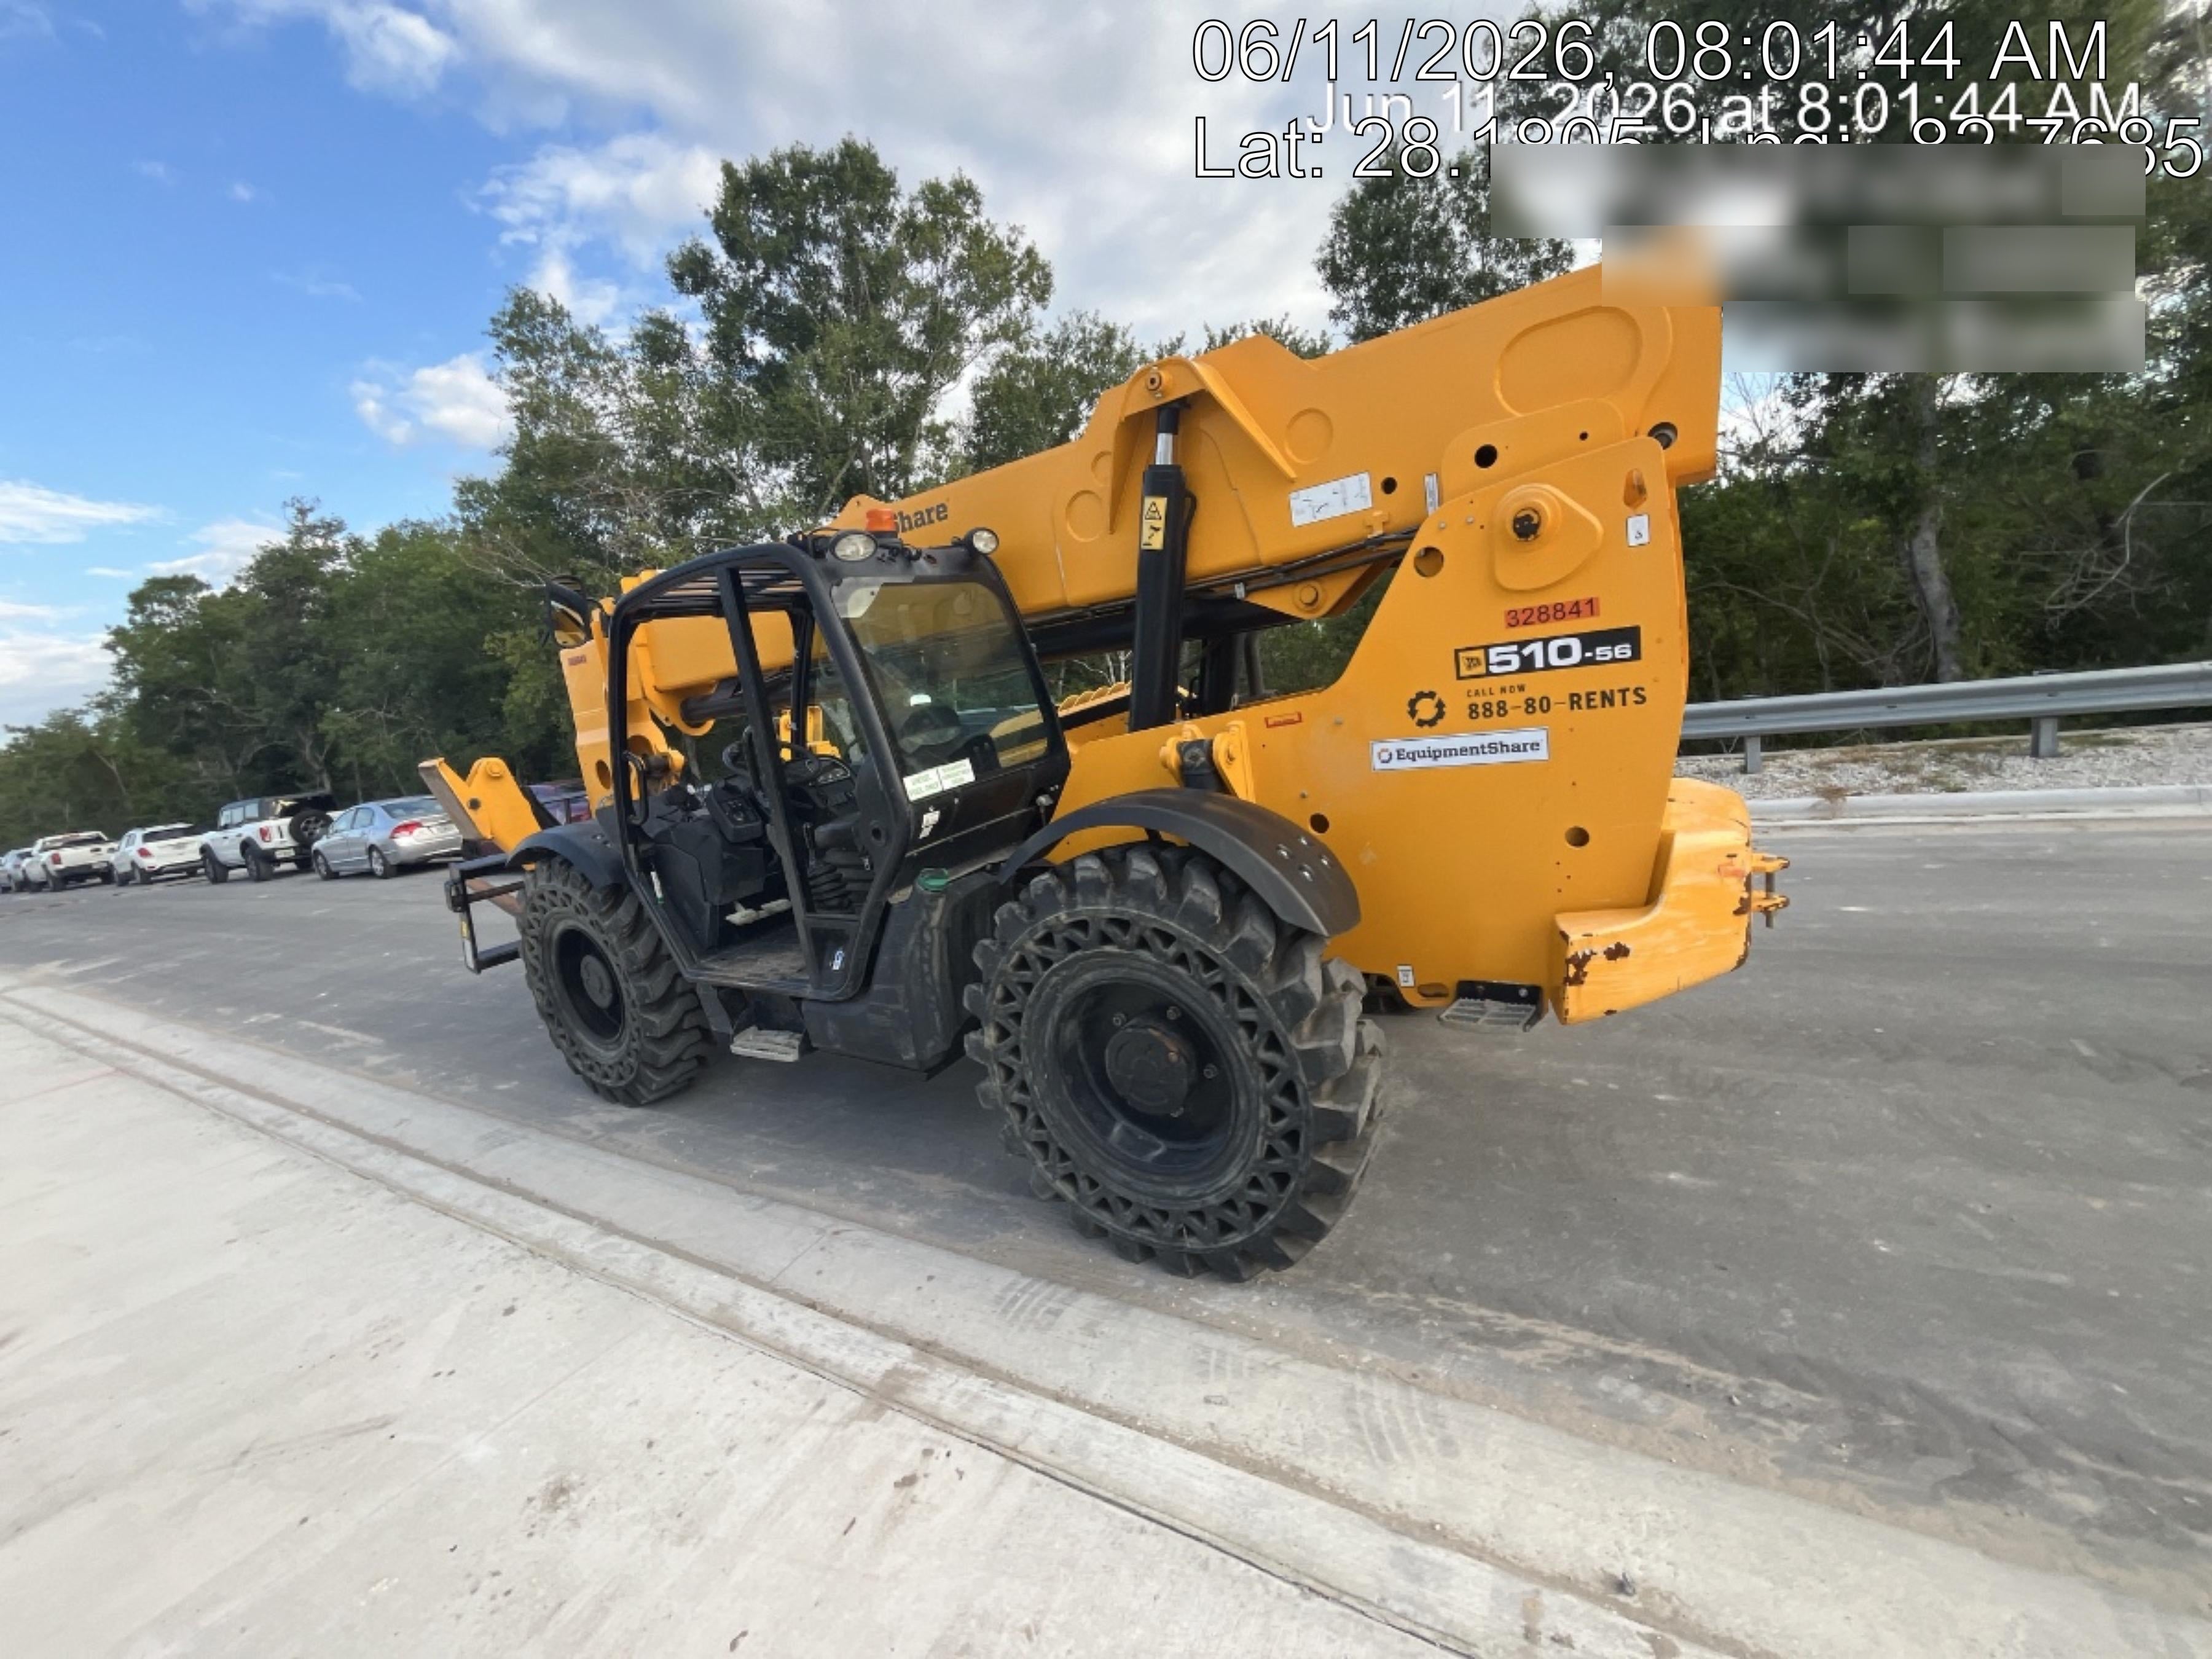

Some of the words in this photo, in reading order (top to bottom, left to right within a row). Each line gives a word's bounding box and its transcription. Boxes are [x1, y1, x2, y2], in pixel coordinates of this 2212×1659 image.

[894, 503, 948, 533] hare
[1507, 597, 1594, 627] 328841
[1488, 637, 1632, 673] 510-56
[1467, 688, 1494, 697] CALL
[1500, 684, 1526, 694] NOW
[1468, 687, 1647, 720] 888-80-RENTS
[1395, 741, 1540, 762] EquipmentShare
